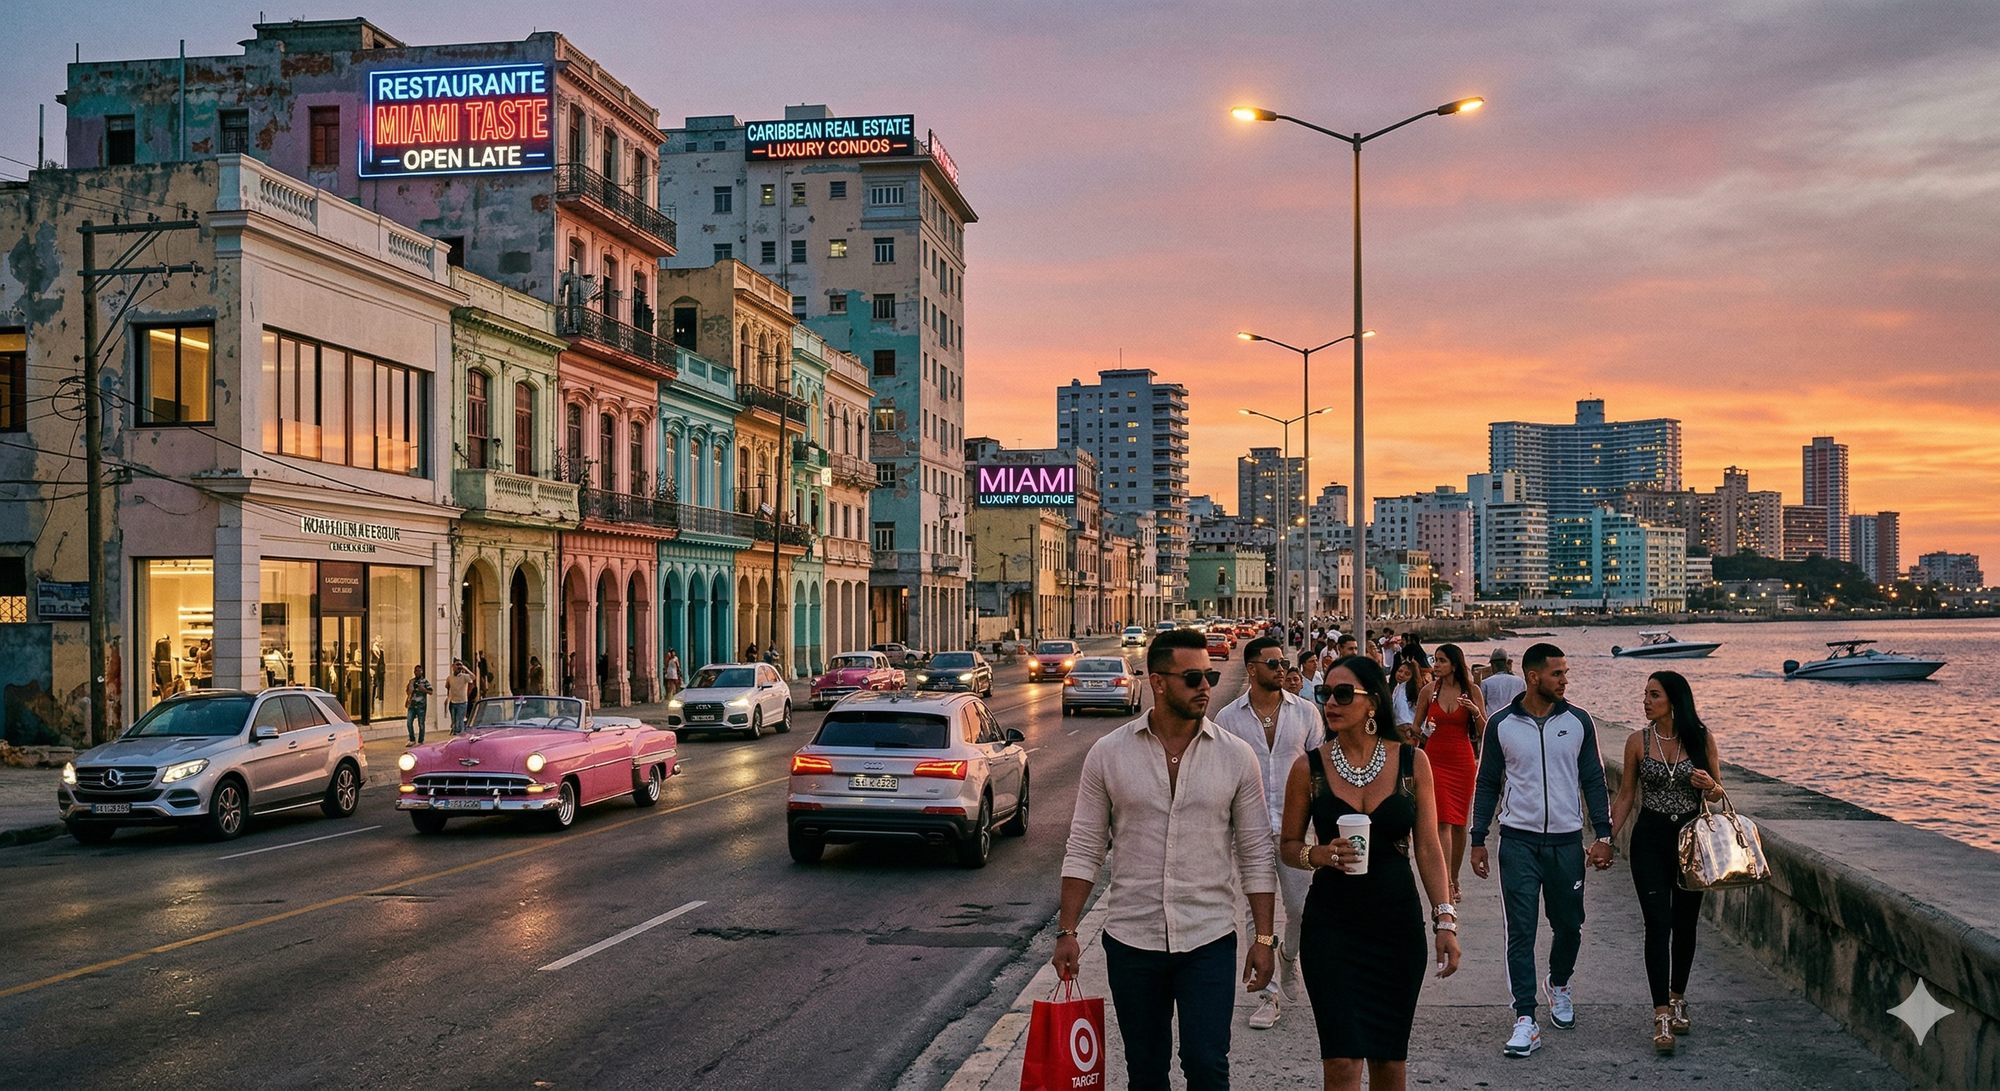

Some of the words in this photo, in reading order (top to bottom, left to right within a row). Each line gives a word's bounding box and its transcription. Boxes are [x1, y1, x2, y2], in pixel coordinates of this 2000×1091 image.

[378, 70, 546, 101] RESTAURANTE
[376, 103, 459, 145] MIAMI
[466, 99, 548, 141] TASTE
[747, 121, 822, 142] CARIBBEAN
[825, 120, 860, 138] REAL
[862, 117, 911, 137] ESTATE
[403, 147, 462, 170] OPEN
[468, 145, 522, 168] LATE
[767, 141, 825, 158] LUXURY
[828, 138, 890, 155] CONDOS
[980, 467, 1074, 493] MIAMI
[980, 494, 1020, 504] LUXURY
[1022, 494, 1075, 505] BOUTIQUE
[1071, 1072, 1100, 1089] TARGET
